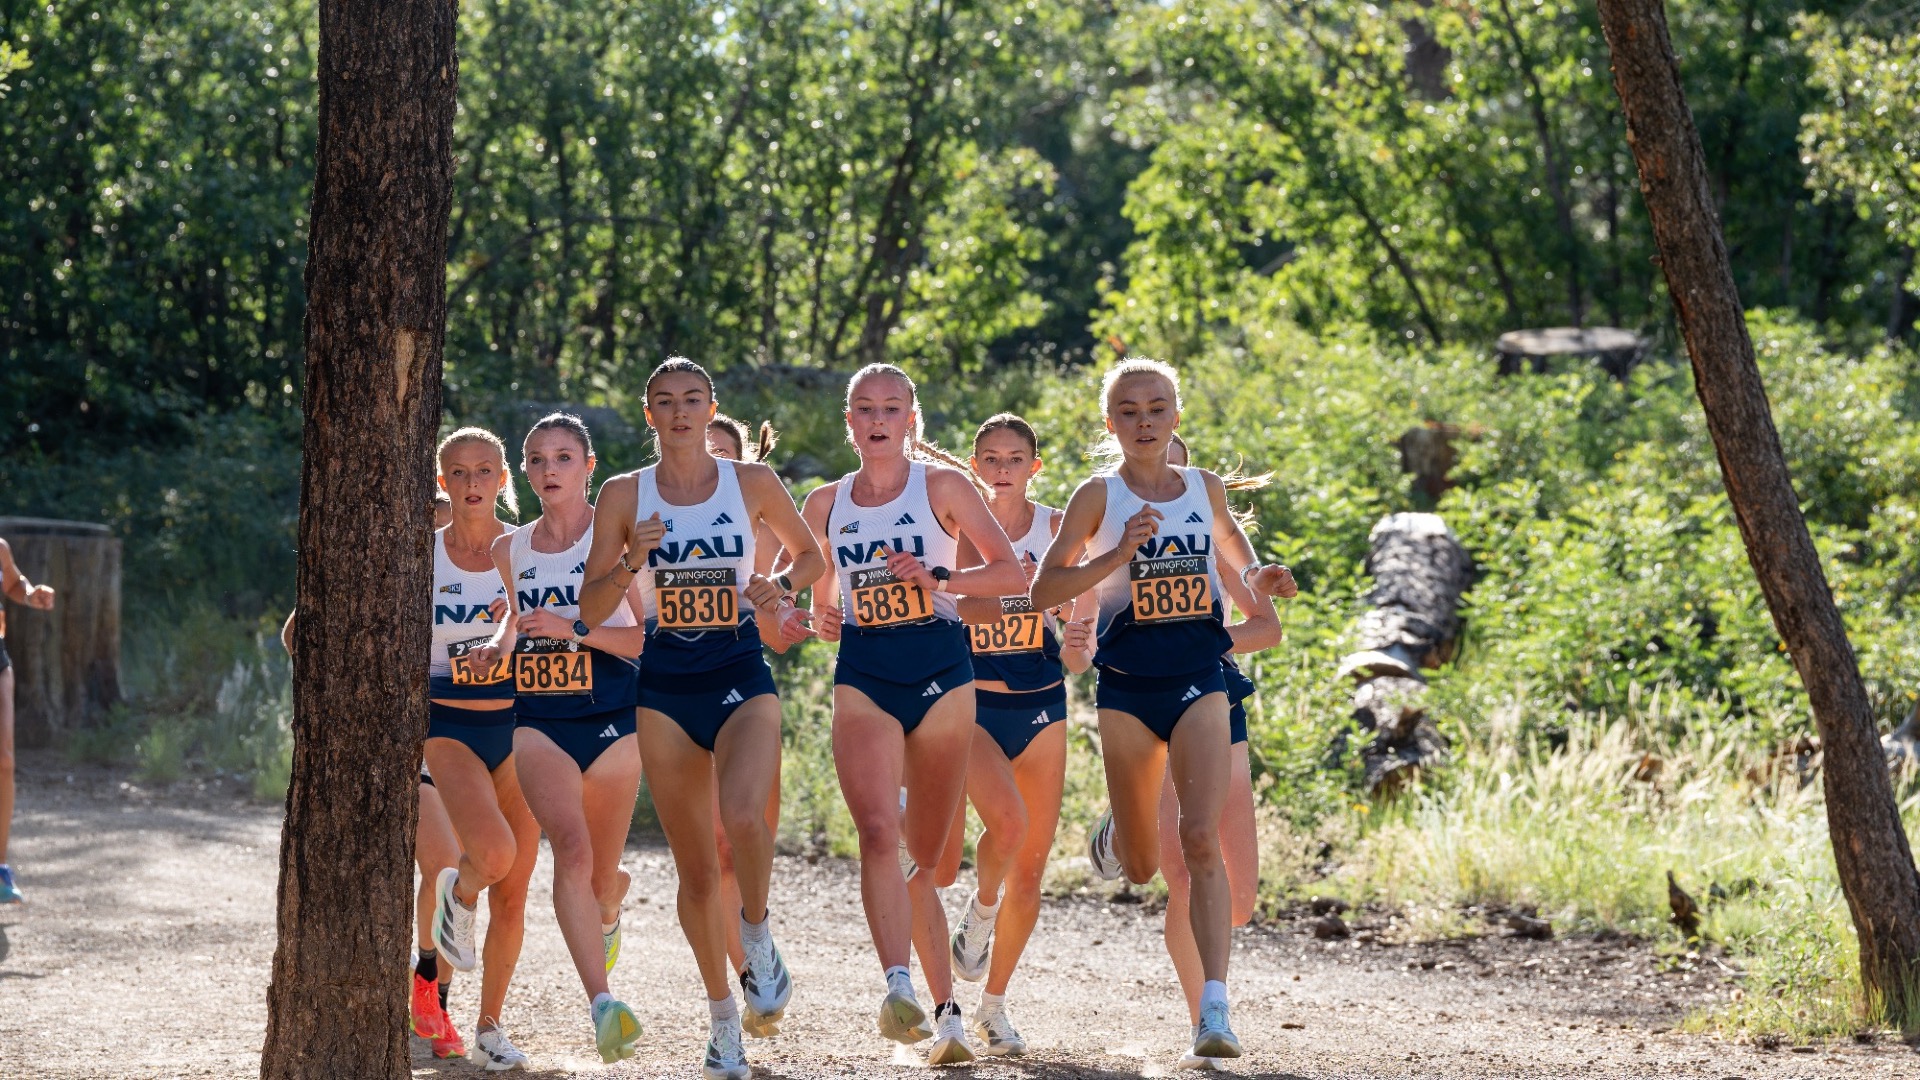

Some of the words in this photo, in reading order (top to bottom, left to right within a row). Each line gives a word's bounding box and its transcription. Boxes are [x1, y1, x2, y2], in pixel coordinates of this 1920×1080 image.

[648, 535, 743, 568] NAU
[837, 536, 924, 568] NAU
[1131, 534, 1210, 561] NAU
[675, 570, 727, 579] WINGFOOT
[867, 568, 894, 580] WING
[1151, 559, 1199, 570] WINGFOOT
[661, 588, 733, 624] 5830
[856, 585, 926, 623] 5831
[1002, 600, 1032, 608] GFOOT
[1137, 577, 1208, 616] 5832
[435, 605, 501, 625] NA
[466, 636, 493, 648] WING
[975, 615, 1038, 649] 5827
[520, 655, 588, 689] 5834
